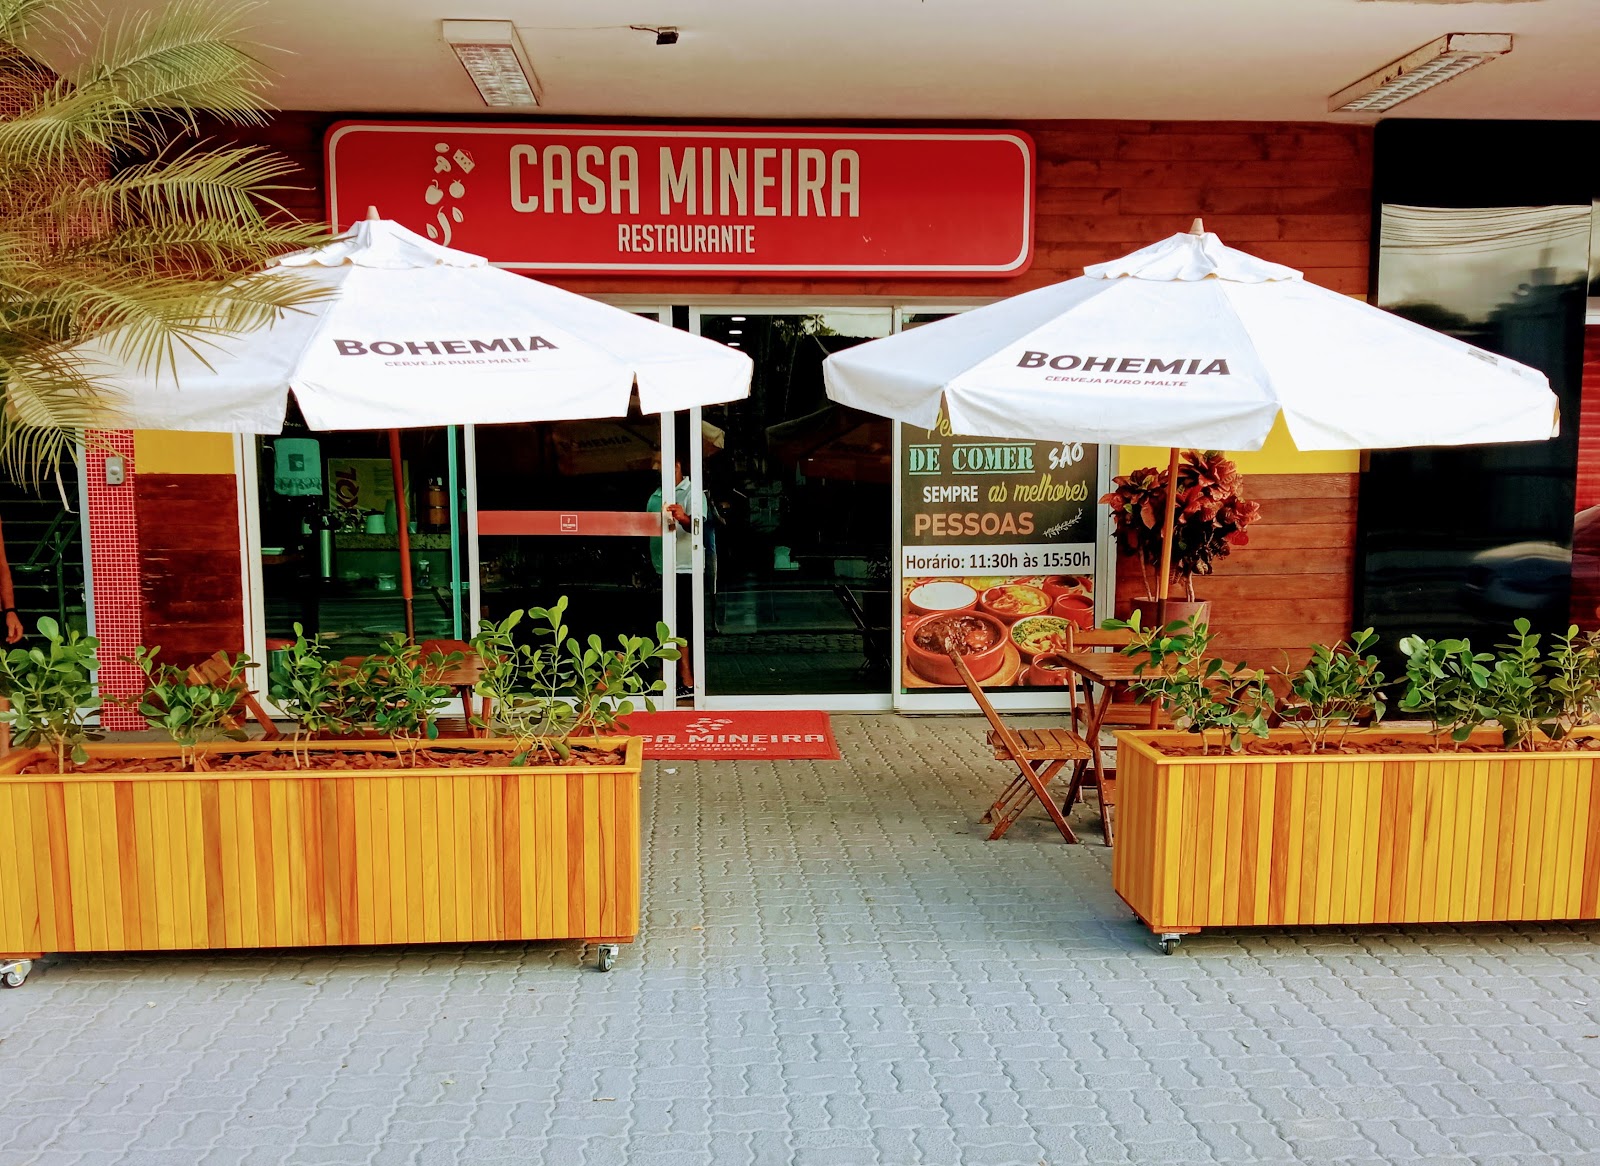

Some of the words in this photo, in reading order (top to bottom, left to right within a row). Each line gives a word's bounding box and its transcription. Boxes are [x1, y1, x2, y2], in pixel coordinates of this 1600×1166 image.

[509, 144, 640, 215] CASA
[659, 146, 861, 219] MINEIRA
[617, 223, 756, 255] RESTAURANTE
[332, 335, 560, 356] BOHEMIA
[1016, 350, 1231, 376] BOHEMIA
[1045, 375, 1102, 384] CERVEJA
[1104, 378, 1141, 386] PURO
[1143, 379, 1189, 387] MALTE
[908, 447, 941, 472] DE
[952, 445, 1035, 472] COMER
[923, 485, 979, 503] SEMPRE
[988, 481, 1008, 503] as
[1013, 473, 1089, 503] melhores
[914, 512, 1035, 537] PESSOAS
[906, 553, 966, 571] Horário:
[969, 553, 1018, 570] 11:30h
[1023, 552, 1039, 568] às
[1043, 551, 1091, 568] 15:50h
[688, 734, 825, 744] MINEIRA
